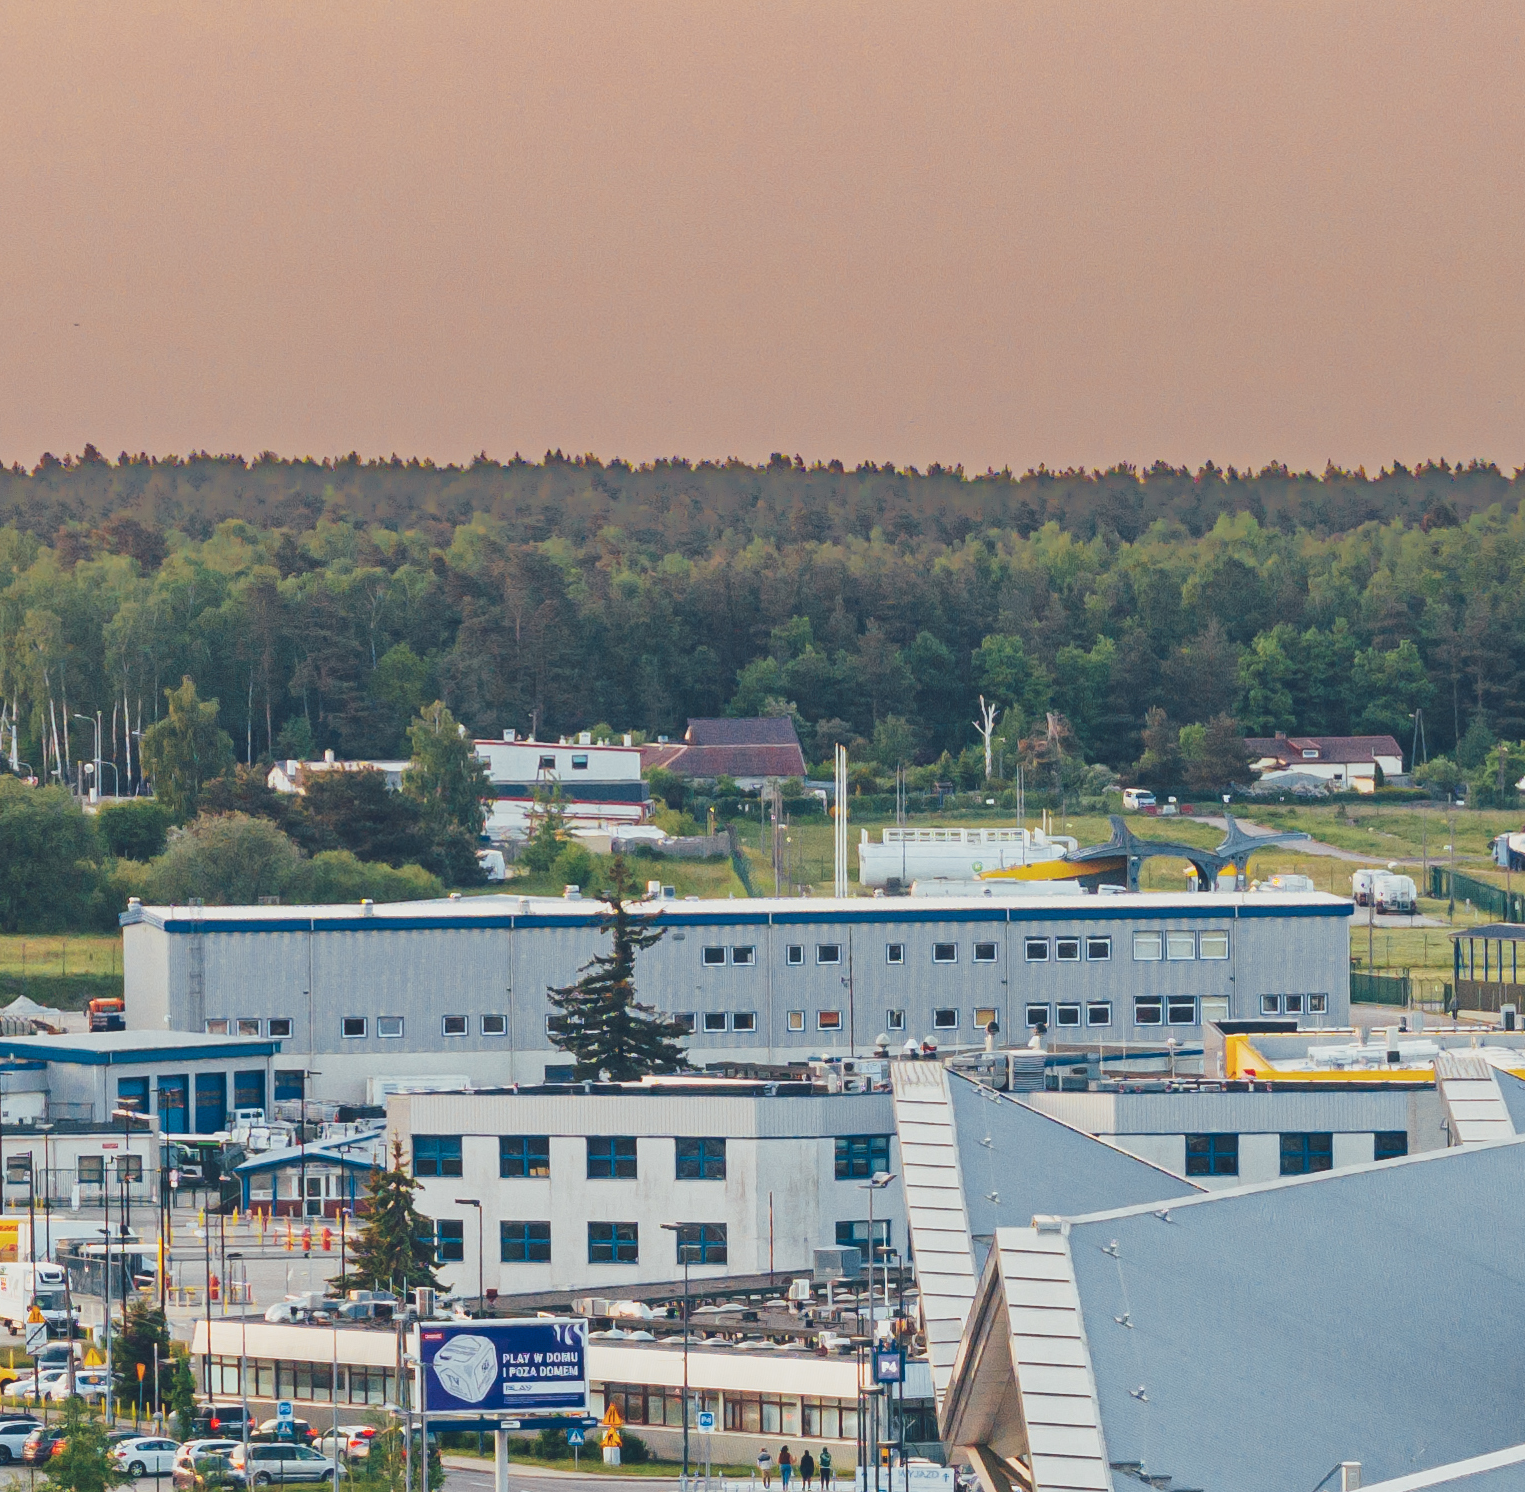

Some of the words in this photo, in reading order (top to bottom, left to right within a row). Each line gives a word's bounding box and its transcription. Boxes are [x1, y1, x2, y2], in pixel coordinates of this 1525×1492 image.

[503, 1353, 530, 1364] PLAY
[534, 1353, 543, 1363] W
[546, 1352, 578, 1363] DOMU
[509, 1366, 537, 1377] POZA
[540, 1365, 578, 1377] DOMEM
[881, 1361, 897, 1374] P4
